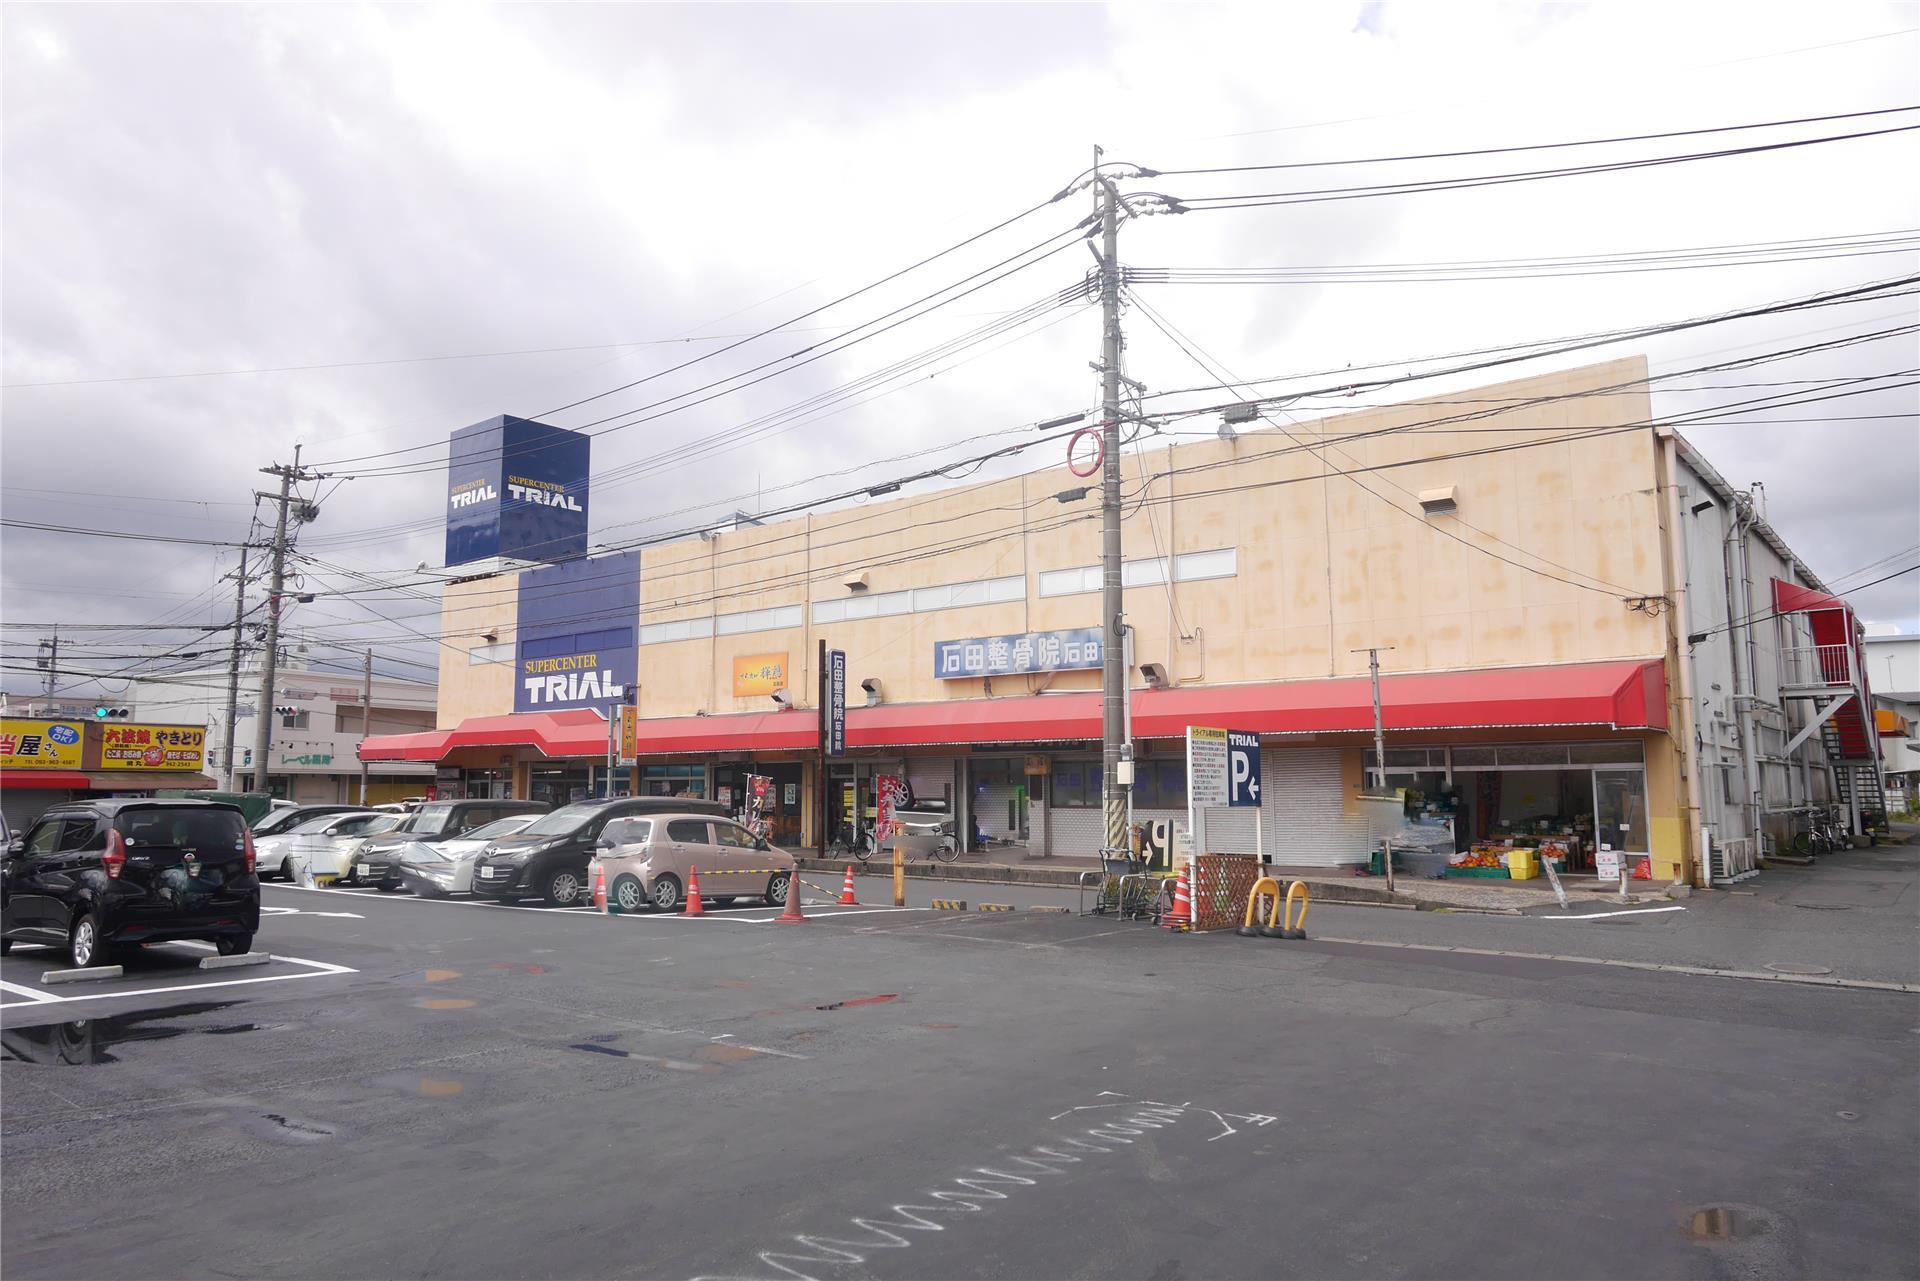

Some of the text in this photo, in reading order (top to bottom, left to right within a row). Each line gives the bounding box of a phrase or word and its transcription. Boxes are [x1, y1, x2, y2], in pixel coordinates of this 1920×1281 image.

[451, 478, 486, 495] SUPERCENTER
[508, 474, 566, 493] SUPERCENTER
[451, 485, 497, 509] TRIAL
[507, 483, 583, 512] TRIAL
[525, 653, 598, 674] SUPERCENTER
[941, 636, 1104, 673] 石田整骨院 石田
[524, 669, 624, 704] TRIAL
[833, 655, 844, 720] 石田整骨院
[155, 730, 203, 746] やきとり
[1228, 733, 1260, 747] TRIAL
[1231, 750, 1250, 802] P
